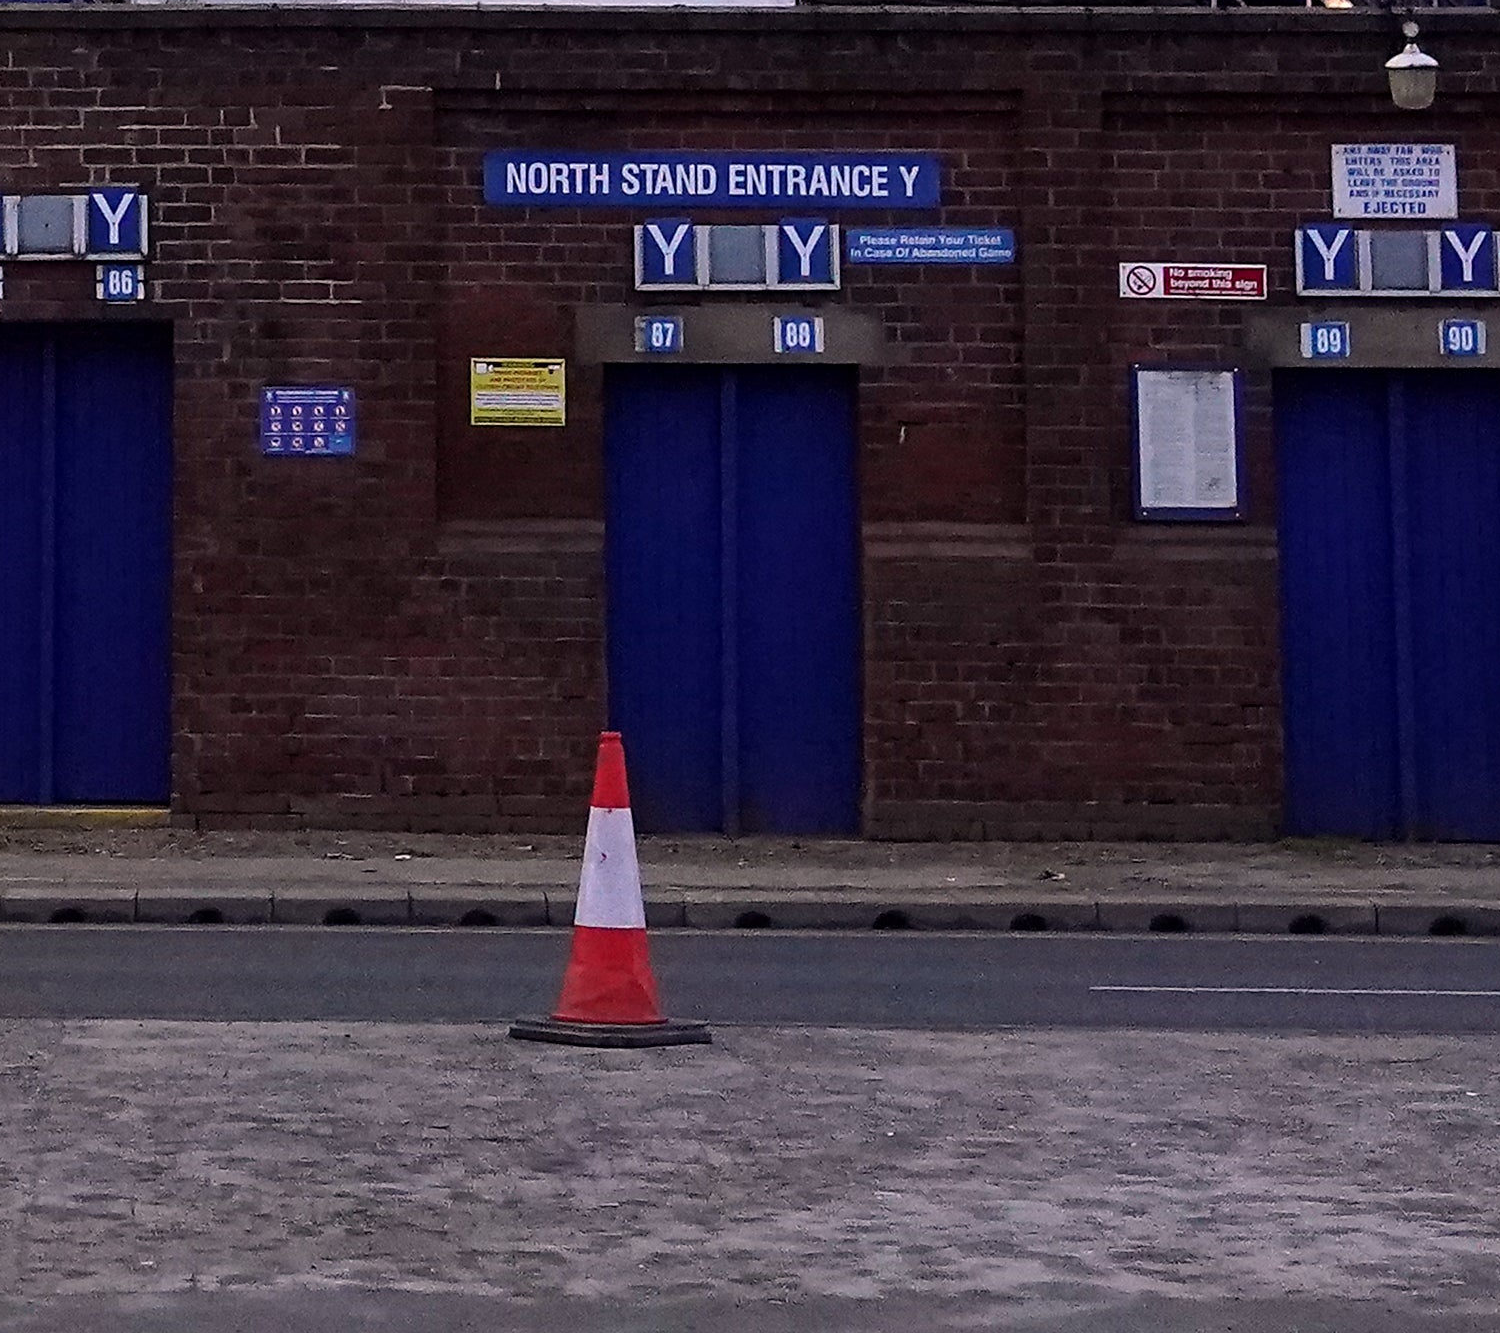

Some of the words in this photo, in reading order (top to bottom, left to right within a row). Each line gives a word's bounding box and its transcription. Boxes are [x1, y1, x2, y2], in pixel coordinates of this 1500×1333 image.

[507, 163, 609, 194] NORTH
[621, 164, 716, 194] STAND
[729, 164, 888, 197] ENTRANCE
[900, 166, 919, 197] Y
[93, 194, 134, 243] Y
[1364, 202, 1426, 213] EJECTED
[646, 225, 689, 274] Y
[783, 226, 825, 276] Y
[860, 236, 897, 245] Please
[901, 235, 935, 244] Retain
[939, 235, 964, 244] Your
[968, 235, 1001, 244] Ticket
[851, 248, 861, 257] In
[865, 248, 892, 257] Case
[896, 248, 908, 257] Of
[912, 248, 975, 257] Abandoned
[979, 248, 1011, 257] Game
[1307, 230, 1349, 280] Y
[1445, 231, 1486, 281] Y
[109, 270, 132, 294] 86
[1171, 279, 1208, 289] beyond
[1212, 279, 1231, 287] this
[1235, 280, 1257, 290] sign
[1188, 269, 1232, 279] smoking
[651, 323, 673, 346] 87
[786, 323, 809, 347] 88
[1317, 328, 1341, 353] 89
[1450, 326, 1473, 351] 90
